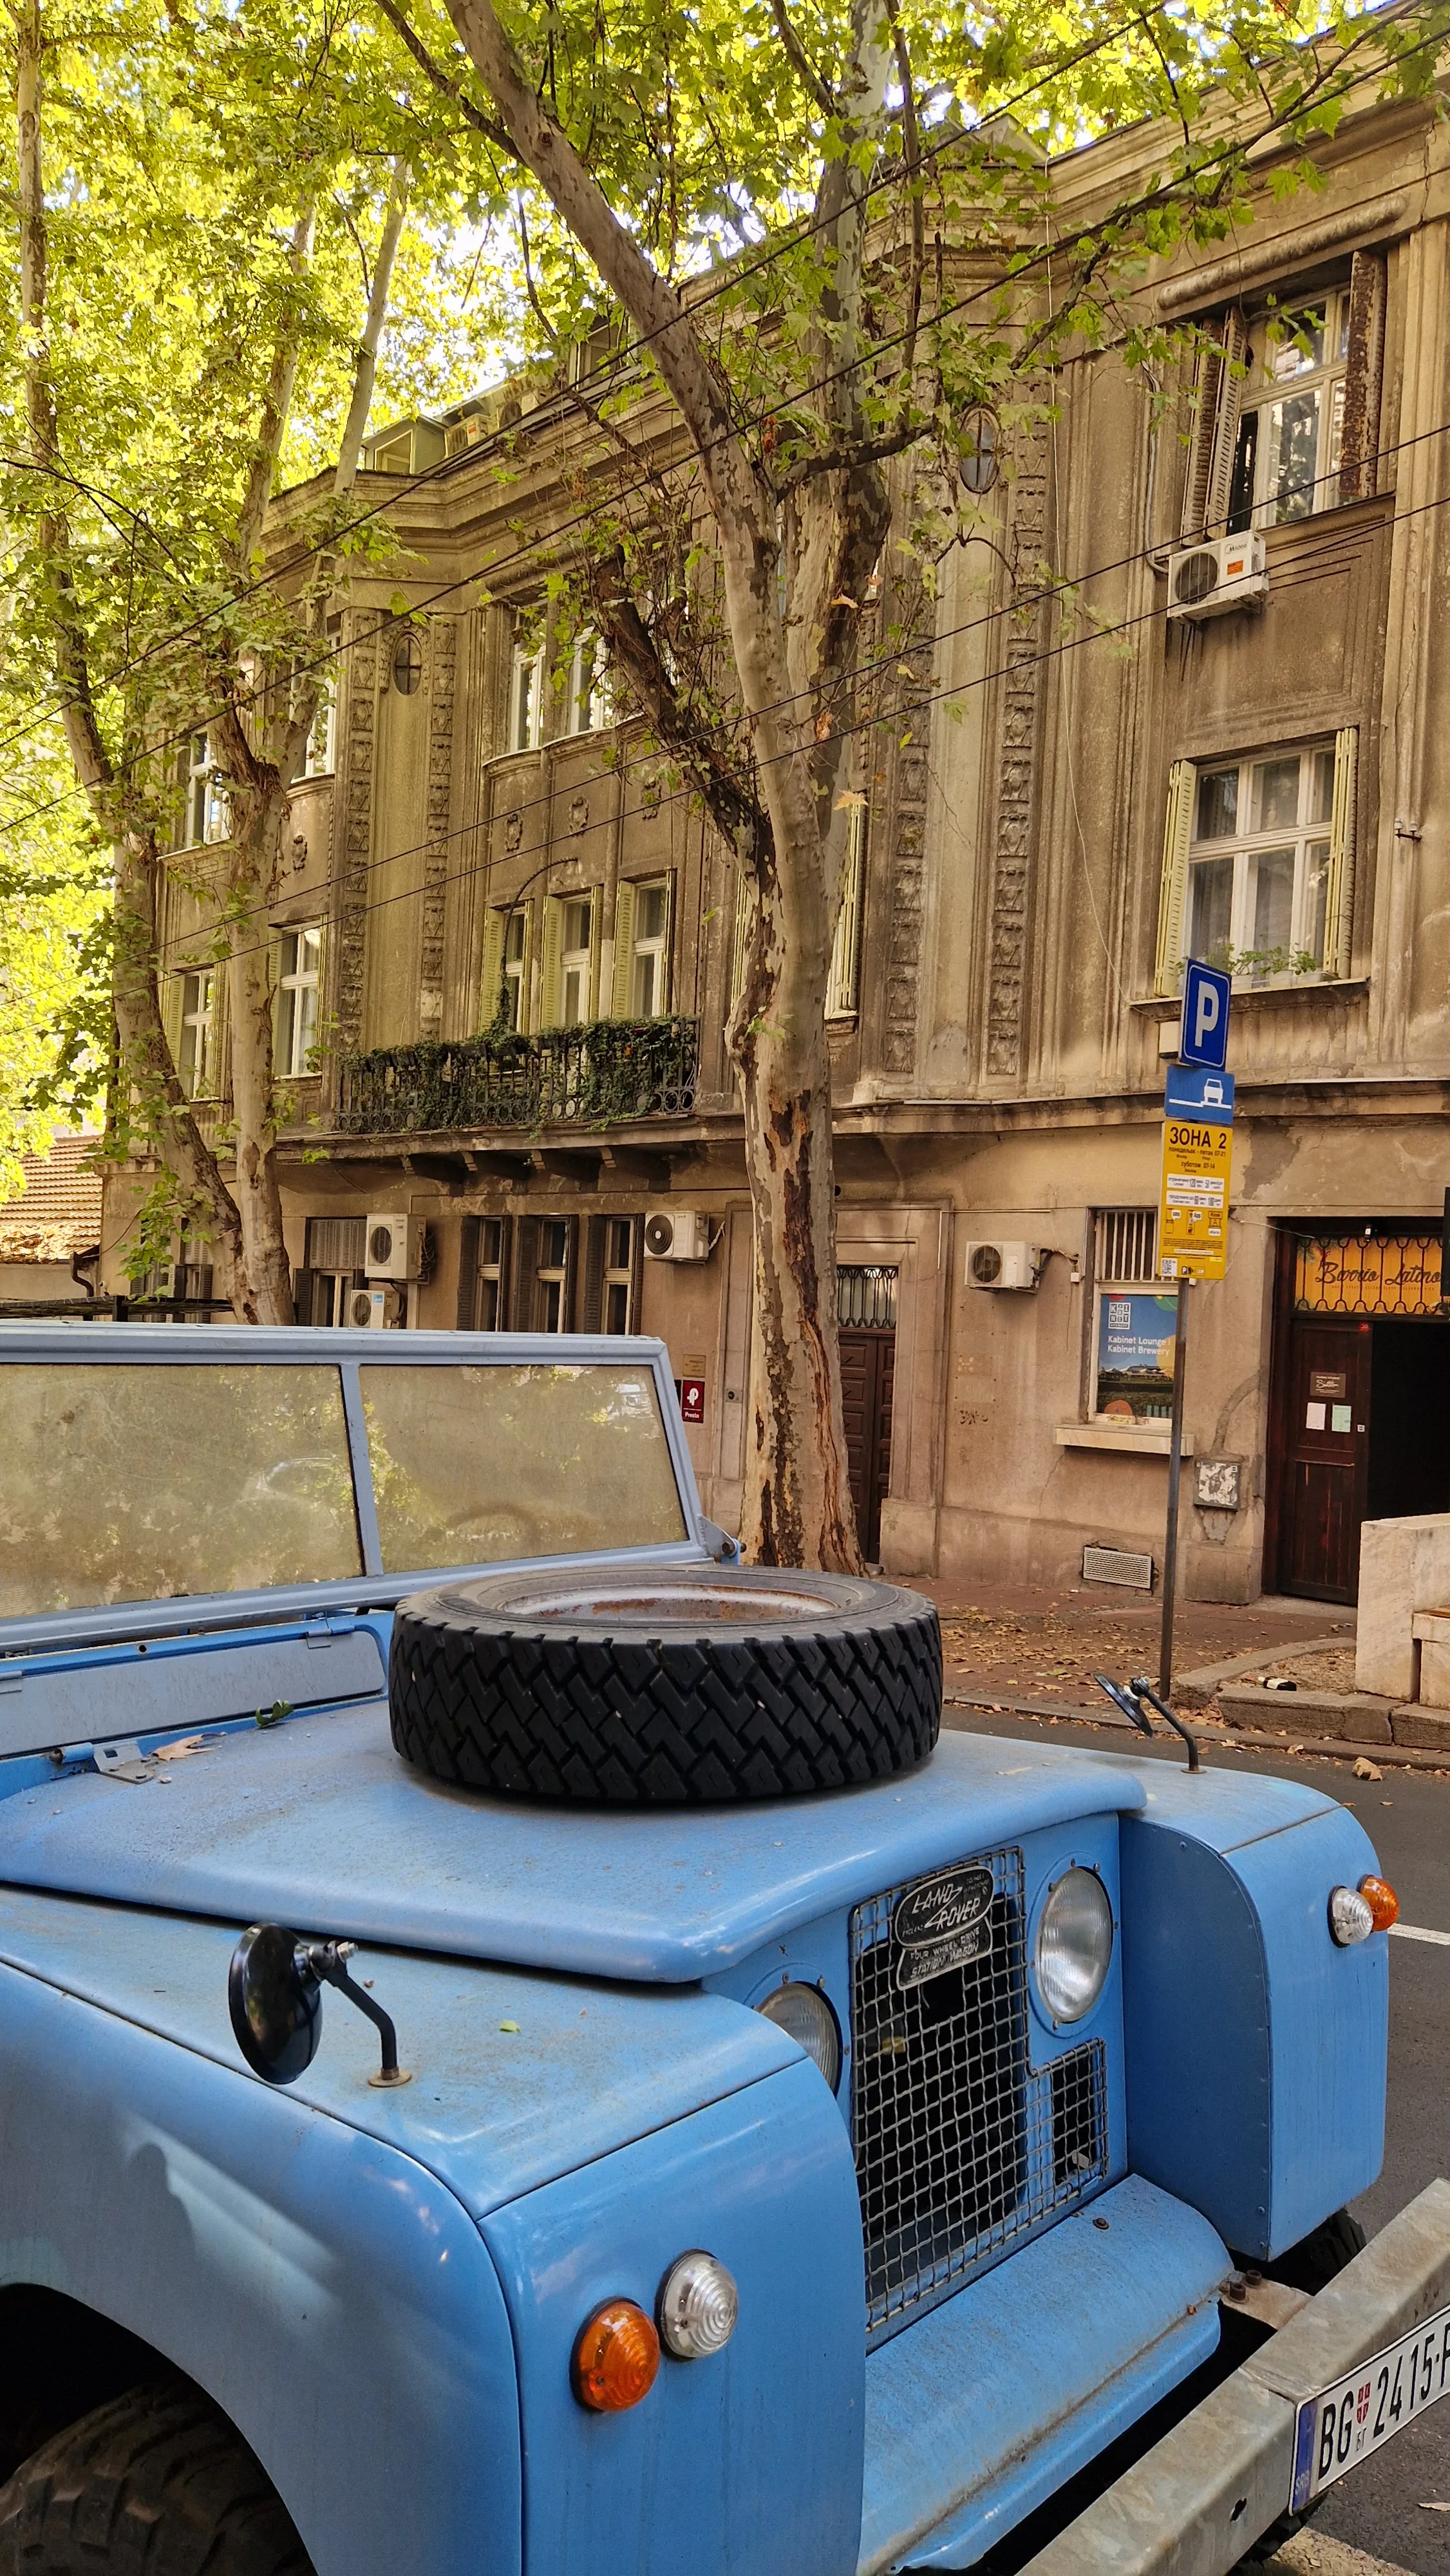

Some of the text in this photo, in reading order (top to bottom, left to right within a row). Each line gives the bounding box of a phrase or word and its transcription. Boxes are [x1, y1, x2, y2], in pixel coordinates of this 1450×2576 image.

[1225, 544, 1247, 554] Midea
[1194, 980, 1219, 1048] P
[1169, 1126, 1227, 1149] ЗОНА 2
[1385, 1264, 1442, 1285] Latino
[1107, 1345, 1170, 1357] Kabinet Brewery
[1108, 1336, 1136, 1344] Kabinet
[1138, 1337, 1166, 1347] Lounge
[912, 1883, 954, 1915] LAND
[936, 1897, 981, 1931] ROVER
[910, 1926, 979, 1960] FOUR WHEEL DRIVE
[910, 1938, 979, 1978] STATION WAGON
[1319, 2391, 1354, 2480] BG
